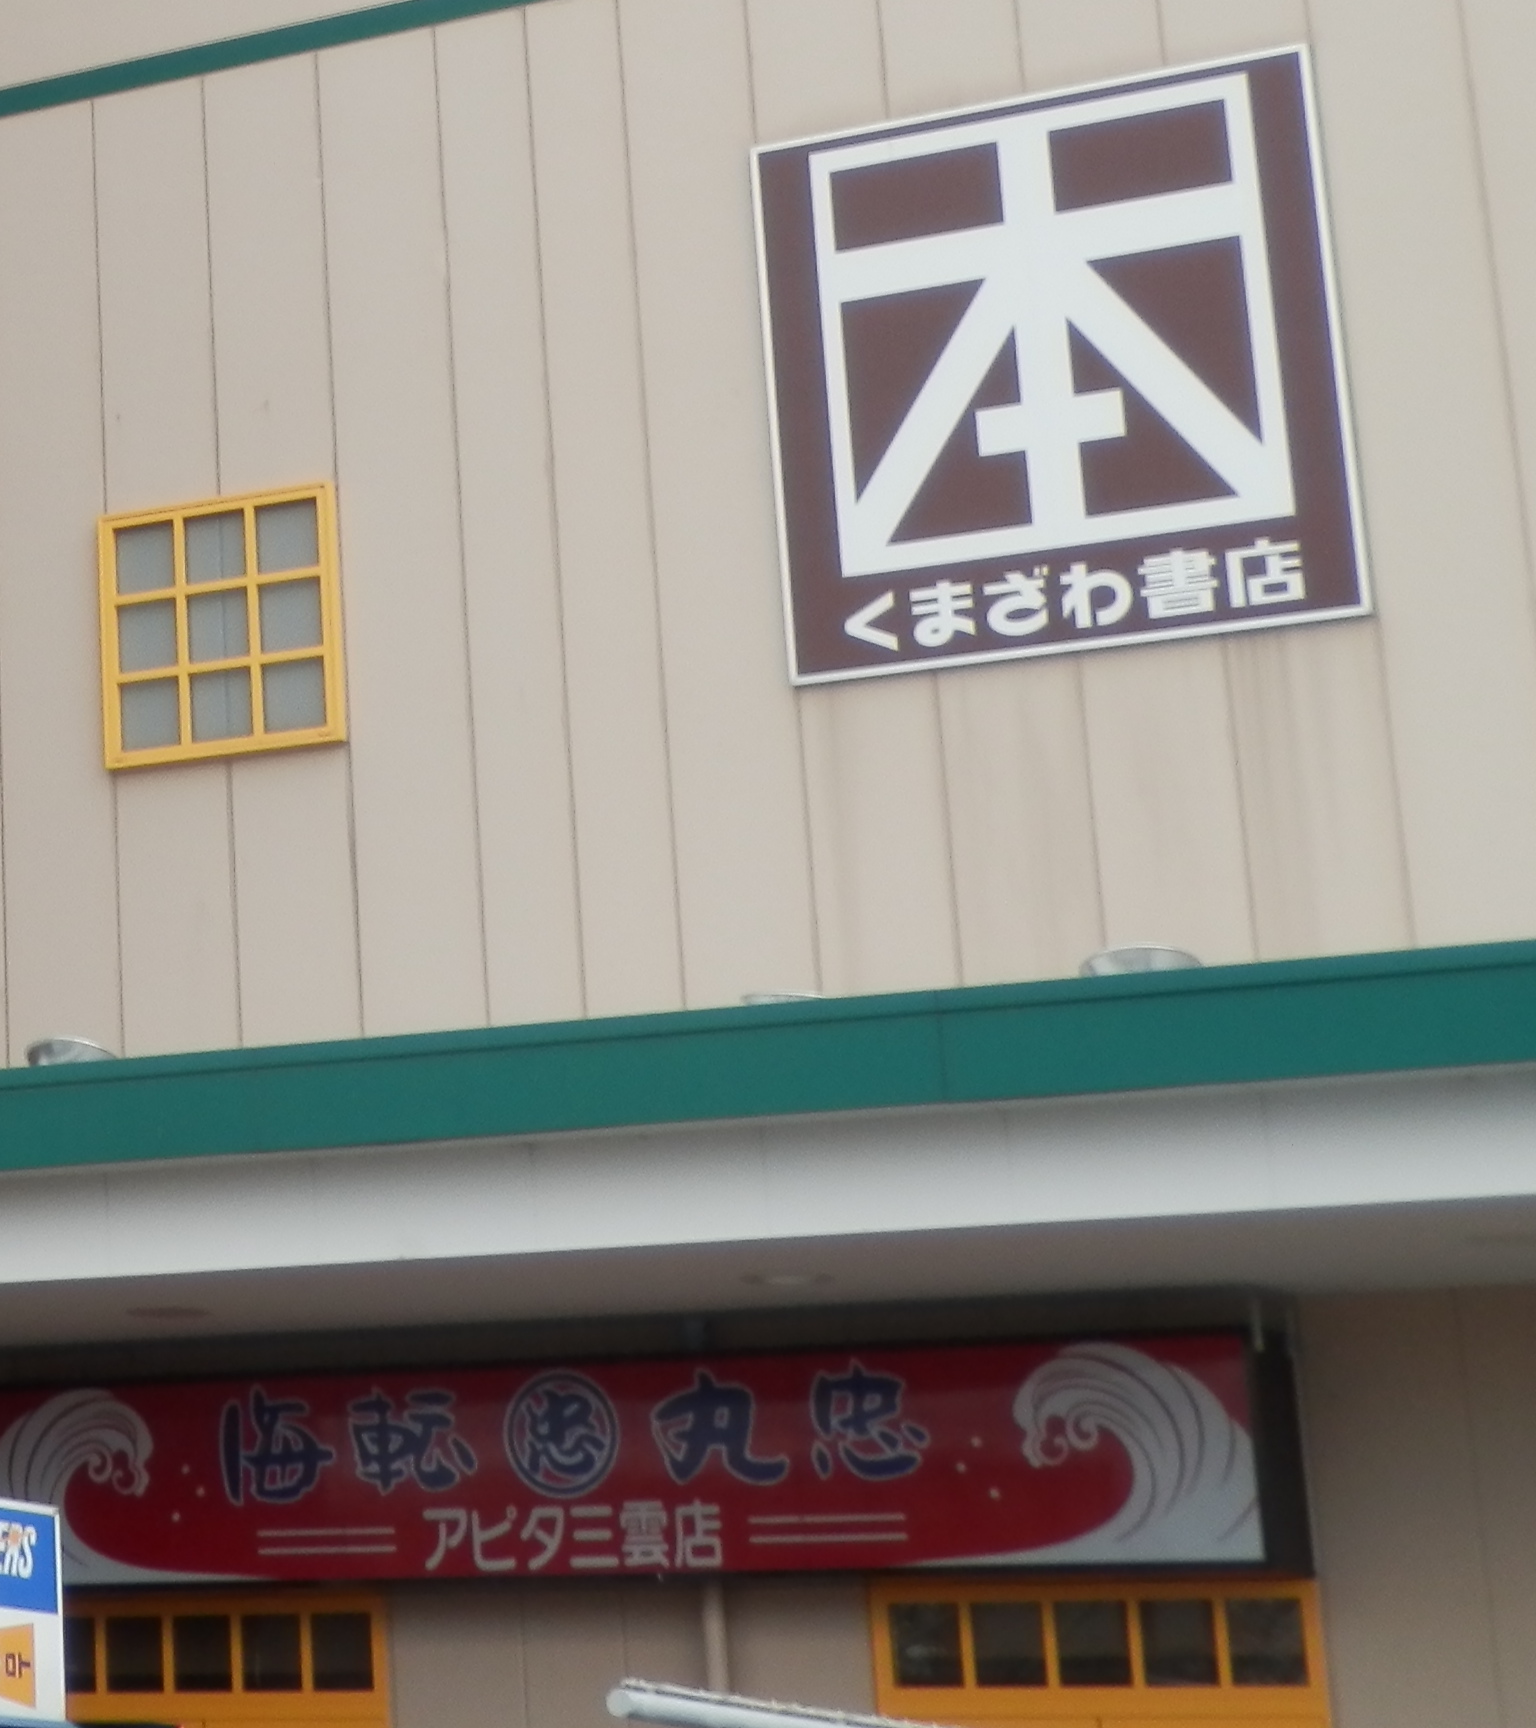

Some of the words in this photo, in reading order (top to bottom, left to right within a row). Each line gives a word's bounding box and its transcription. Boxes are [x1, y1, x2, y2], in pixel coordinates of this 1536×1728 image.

[843, 537, 1306, 652] くまざわ書店
[422, 1500, 725, 1572] アピタ三雲店
